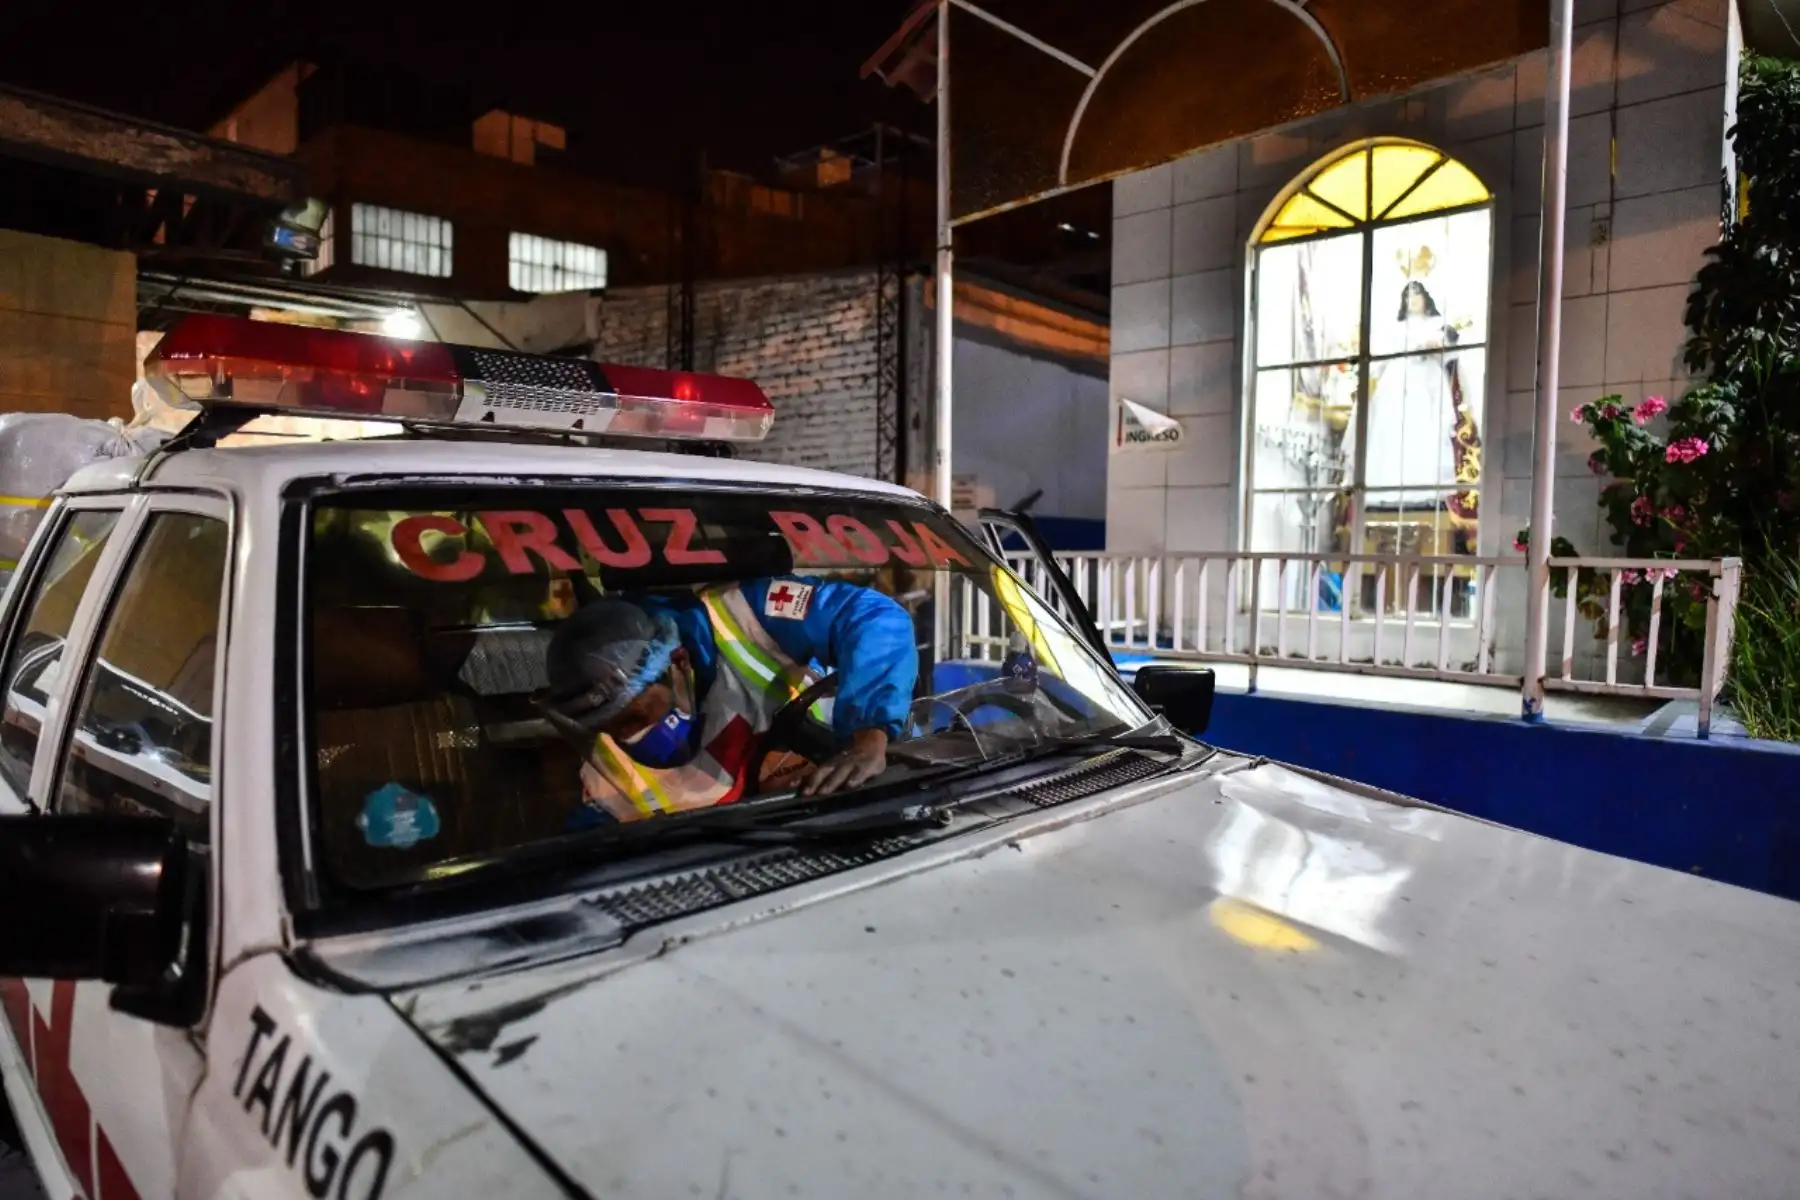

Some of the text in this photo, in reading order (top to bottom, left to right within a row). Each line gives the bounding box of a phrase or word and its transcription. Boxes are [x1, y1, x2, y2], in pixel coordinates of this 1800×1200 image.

[391, 508, 974, 581] CRUZ ROJA
[233, 1004, 395, 1200] TANGO
